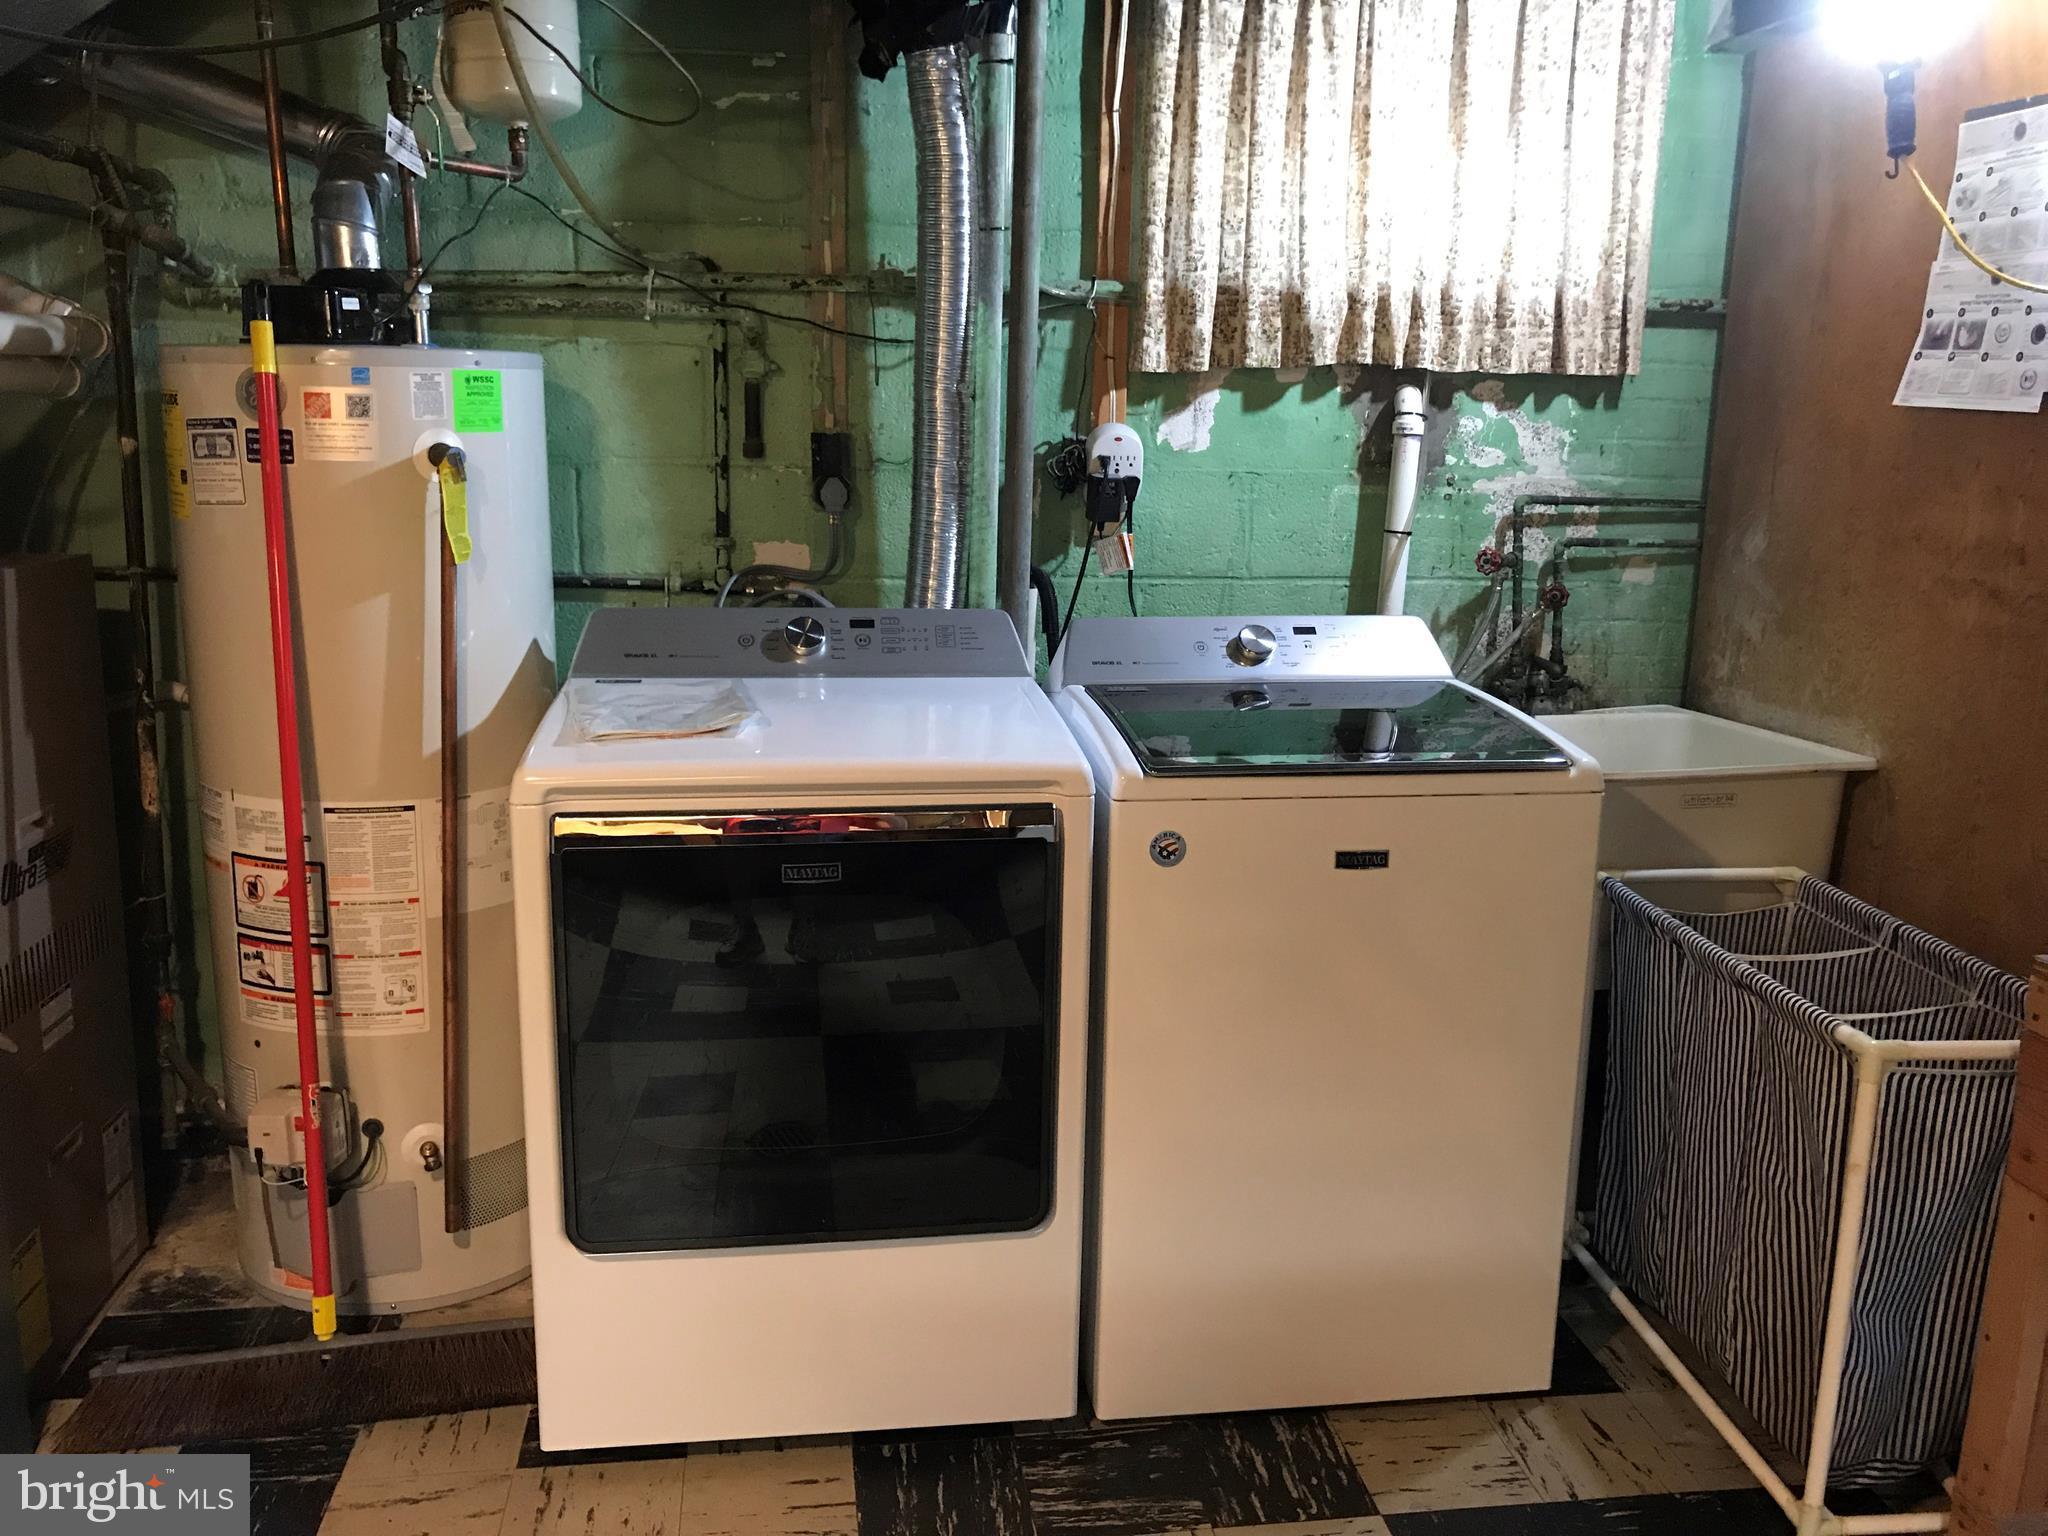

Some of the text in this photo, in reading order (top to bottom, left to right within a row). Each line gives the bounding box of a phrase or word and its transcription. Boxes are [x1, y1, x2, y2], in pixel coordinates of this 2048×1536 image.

[472, 375, 494, 383] WSSC
[1338, 854, 1386, 865] MAYTAG
[261, 863, 288, 871] WARNIN
[785, 866, 838, 879] MAYTAG
[1, 861, 37, 906] Ultra
